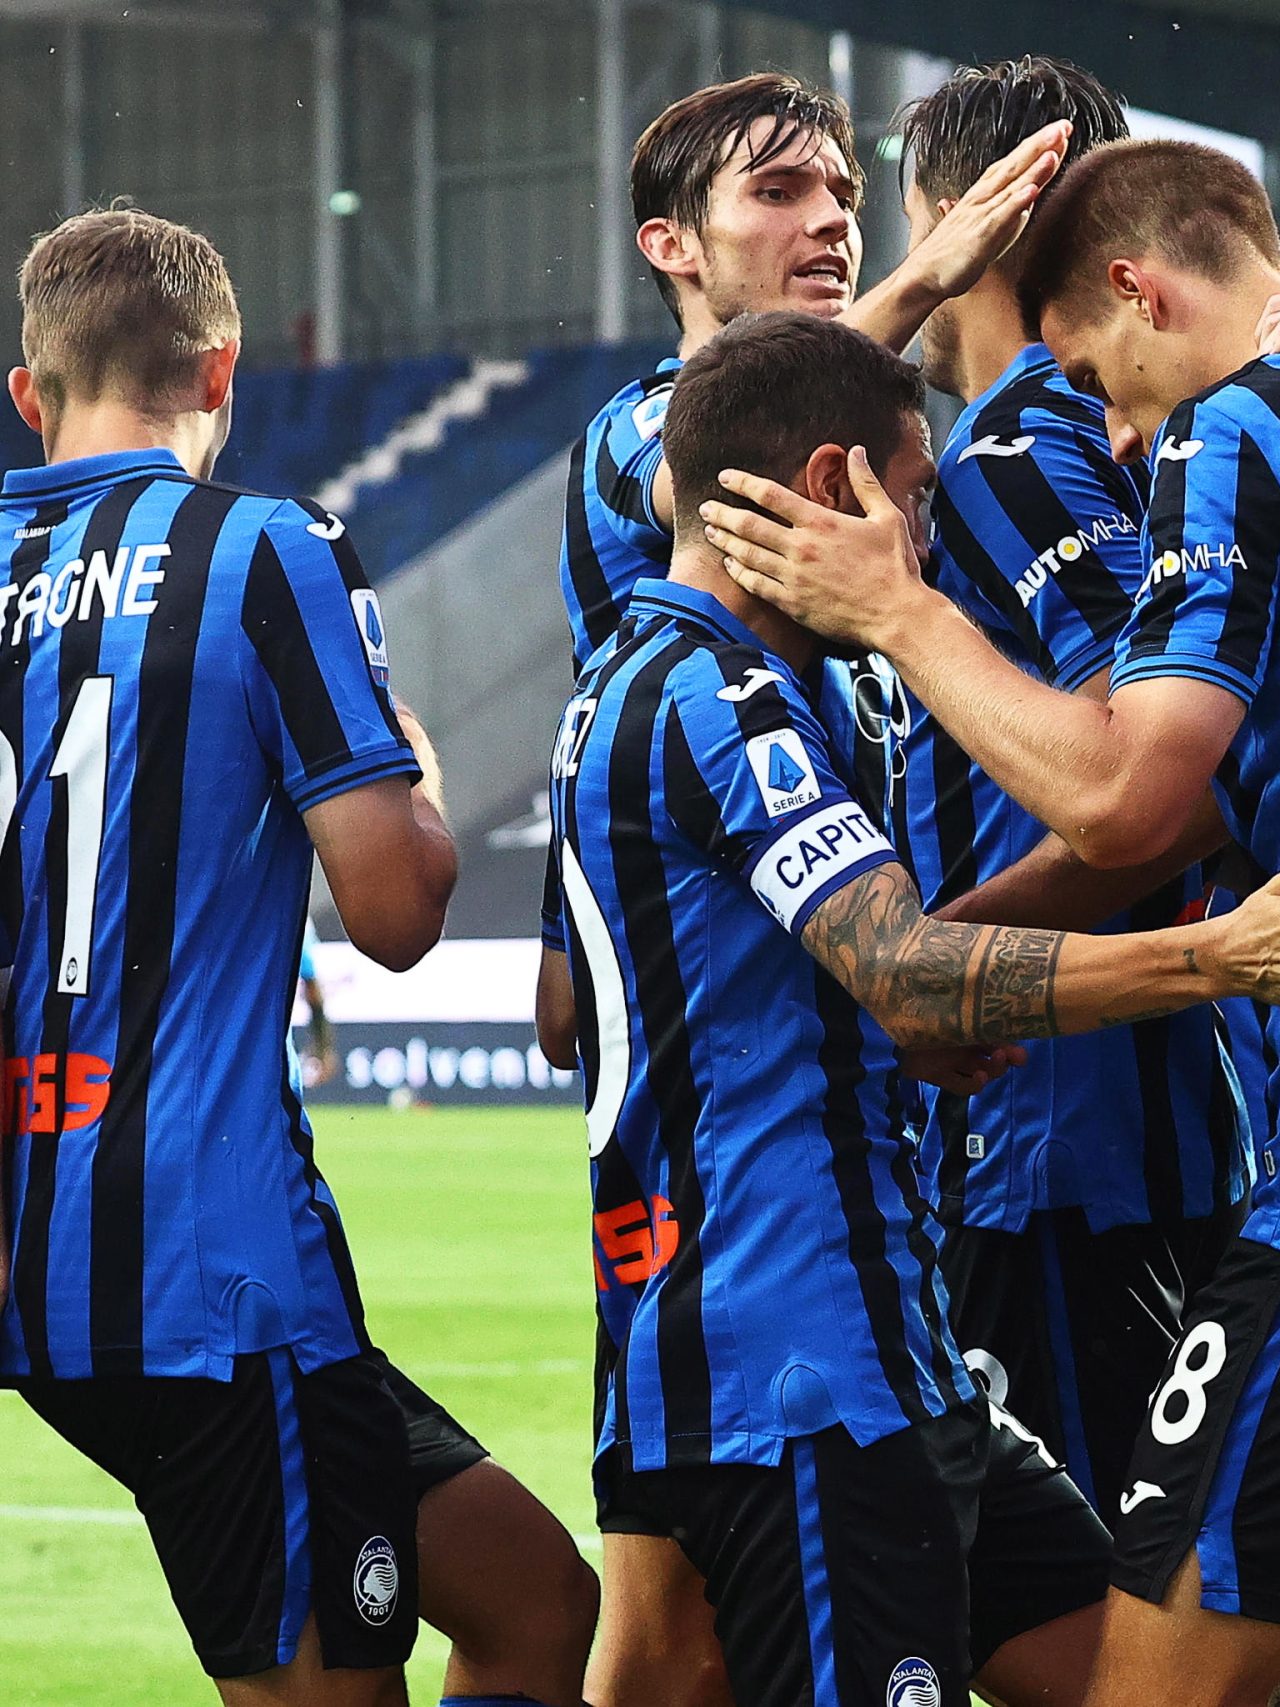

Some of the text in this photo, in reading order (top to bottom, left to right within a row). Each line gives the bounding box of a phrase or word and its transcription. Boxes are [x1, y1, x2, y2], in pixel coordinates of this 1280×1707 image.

[1014, 512, 1138, 608] AUTOMHA
[0, 677, 113, 995] 1
[773, 791, 816, 812] SERIE A
[776, 813, 882, 890] CAPIT
[1148, 1320, 1227, 1446] 8
[368, 1604, 389, 1616] 1907
[892, 1667, 933, 1683] ATALANTA
